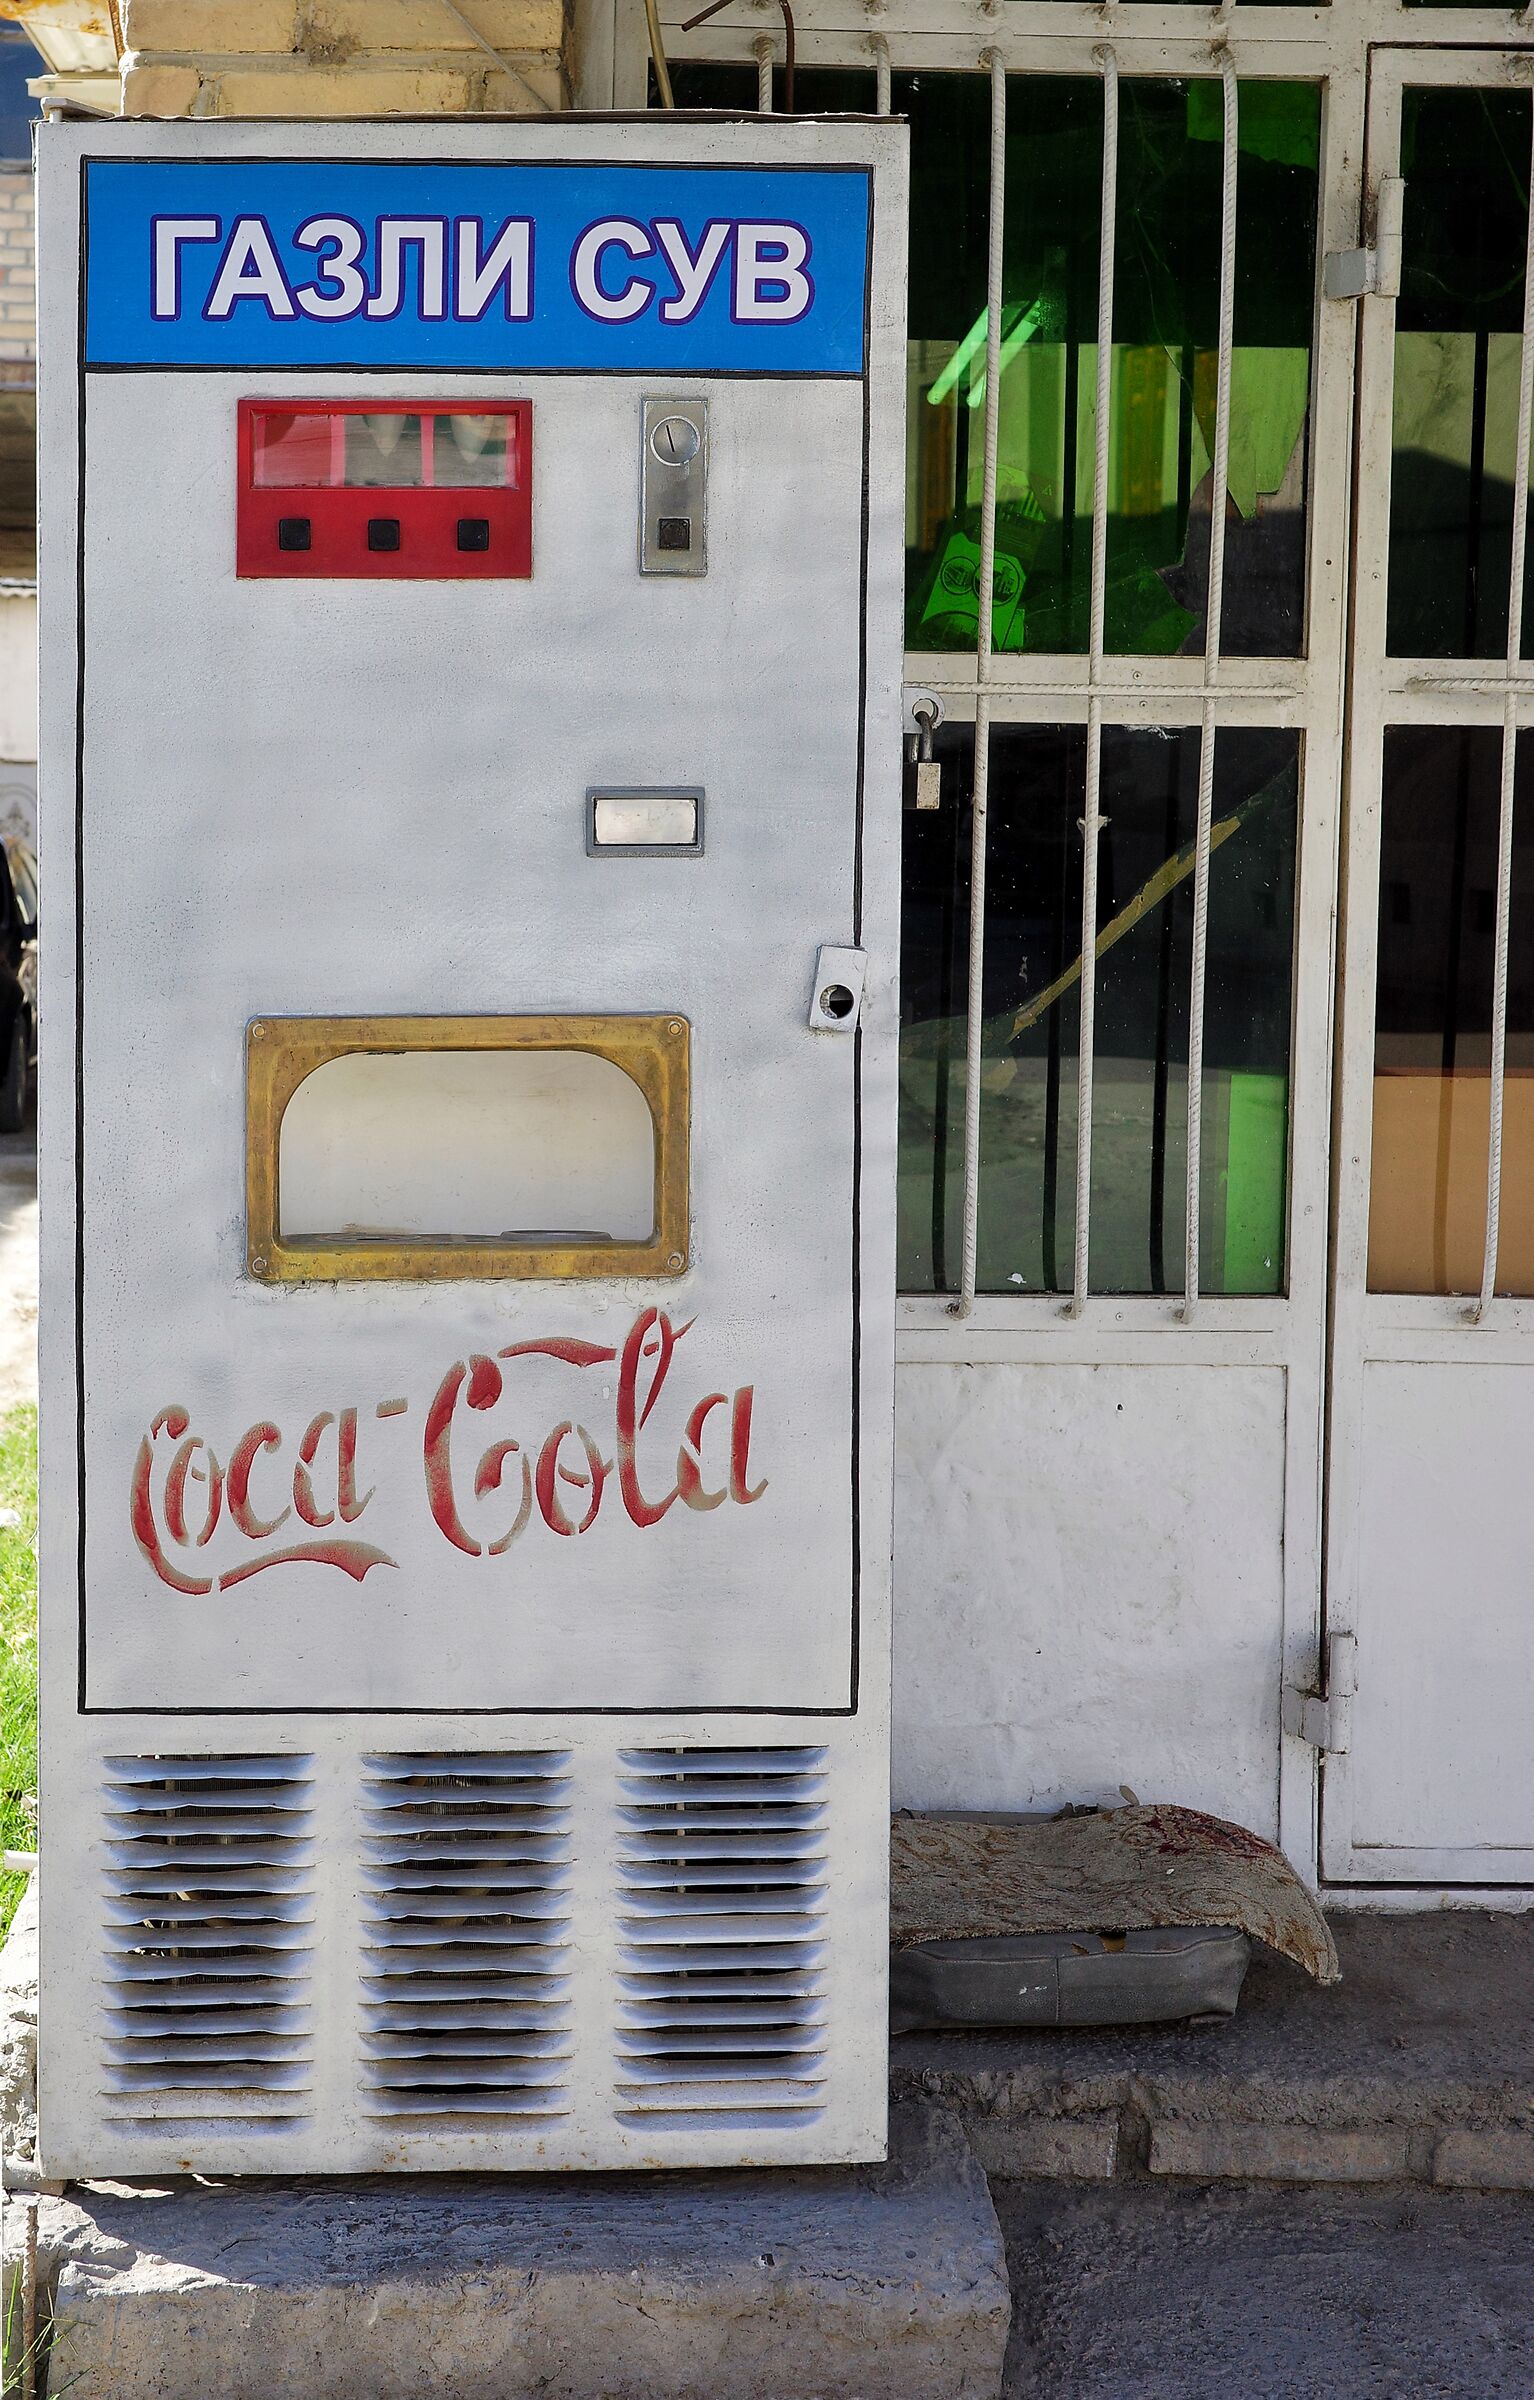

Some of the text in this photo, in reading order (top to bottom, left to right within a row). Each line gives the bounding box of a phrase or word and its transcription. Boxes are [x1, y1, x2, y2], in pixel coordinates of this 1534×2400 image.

[151, 214, 814, 325] ГАЗЛИ СУВ
[130, 1306, 768, 1594] Coca-Cola
